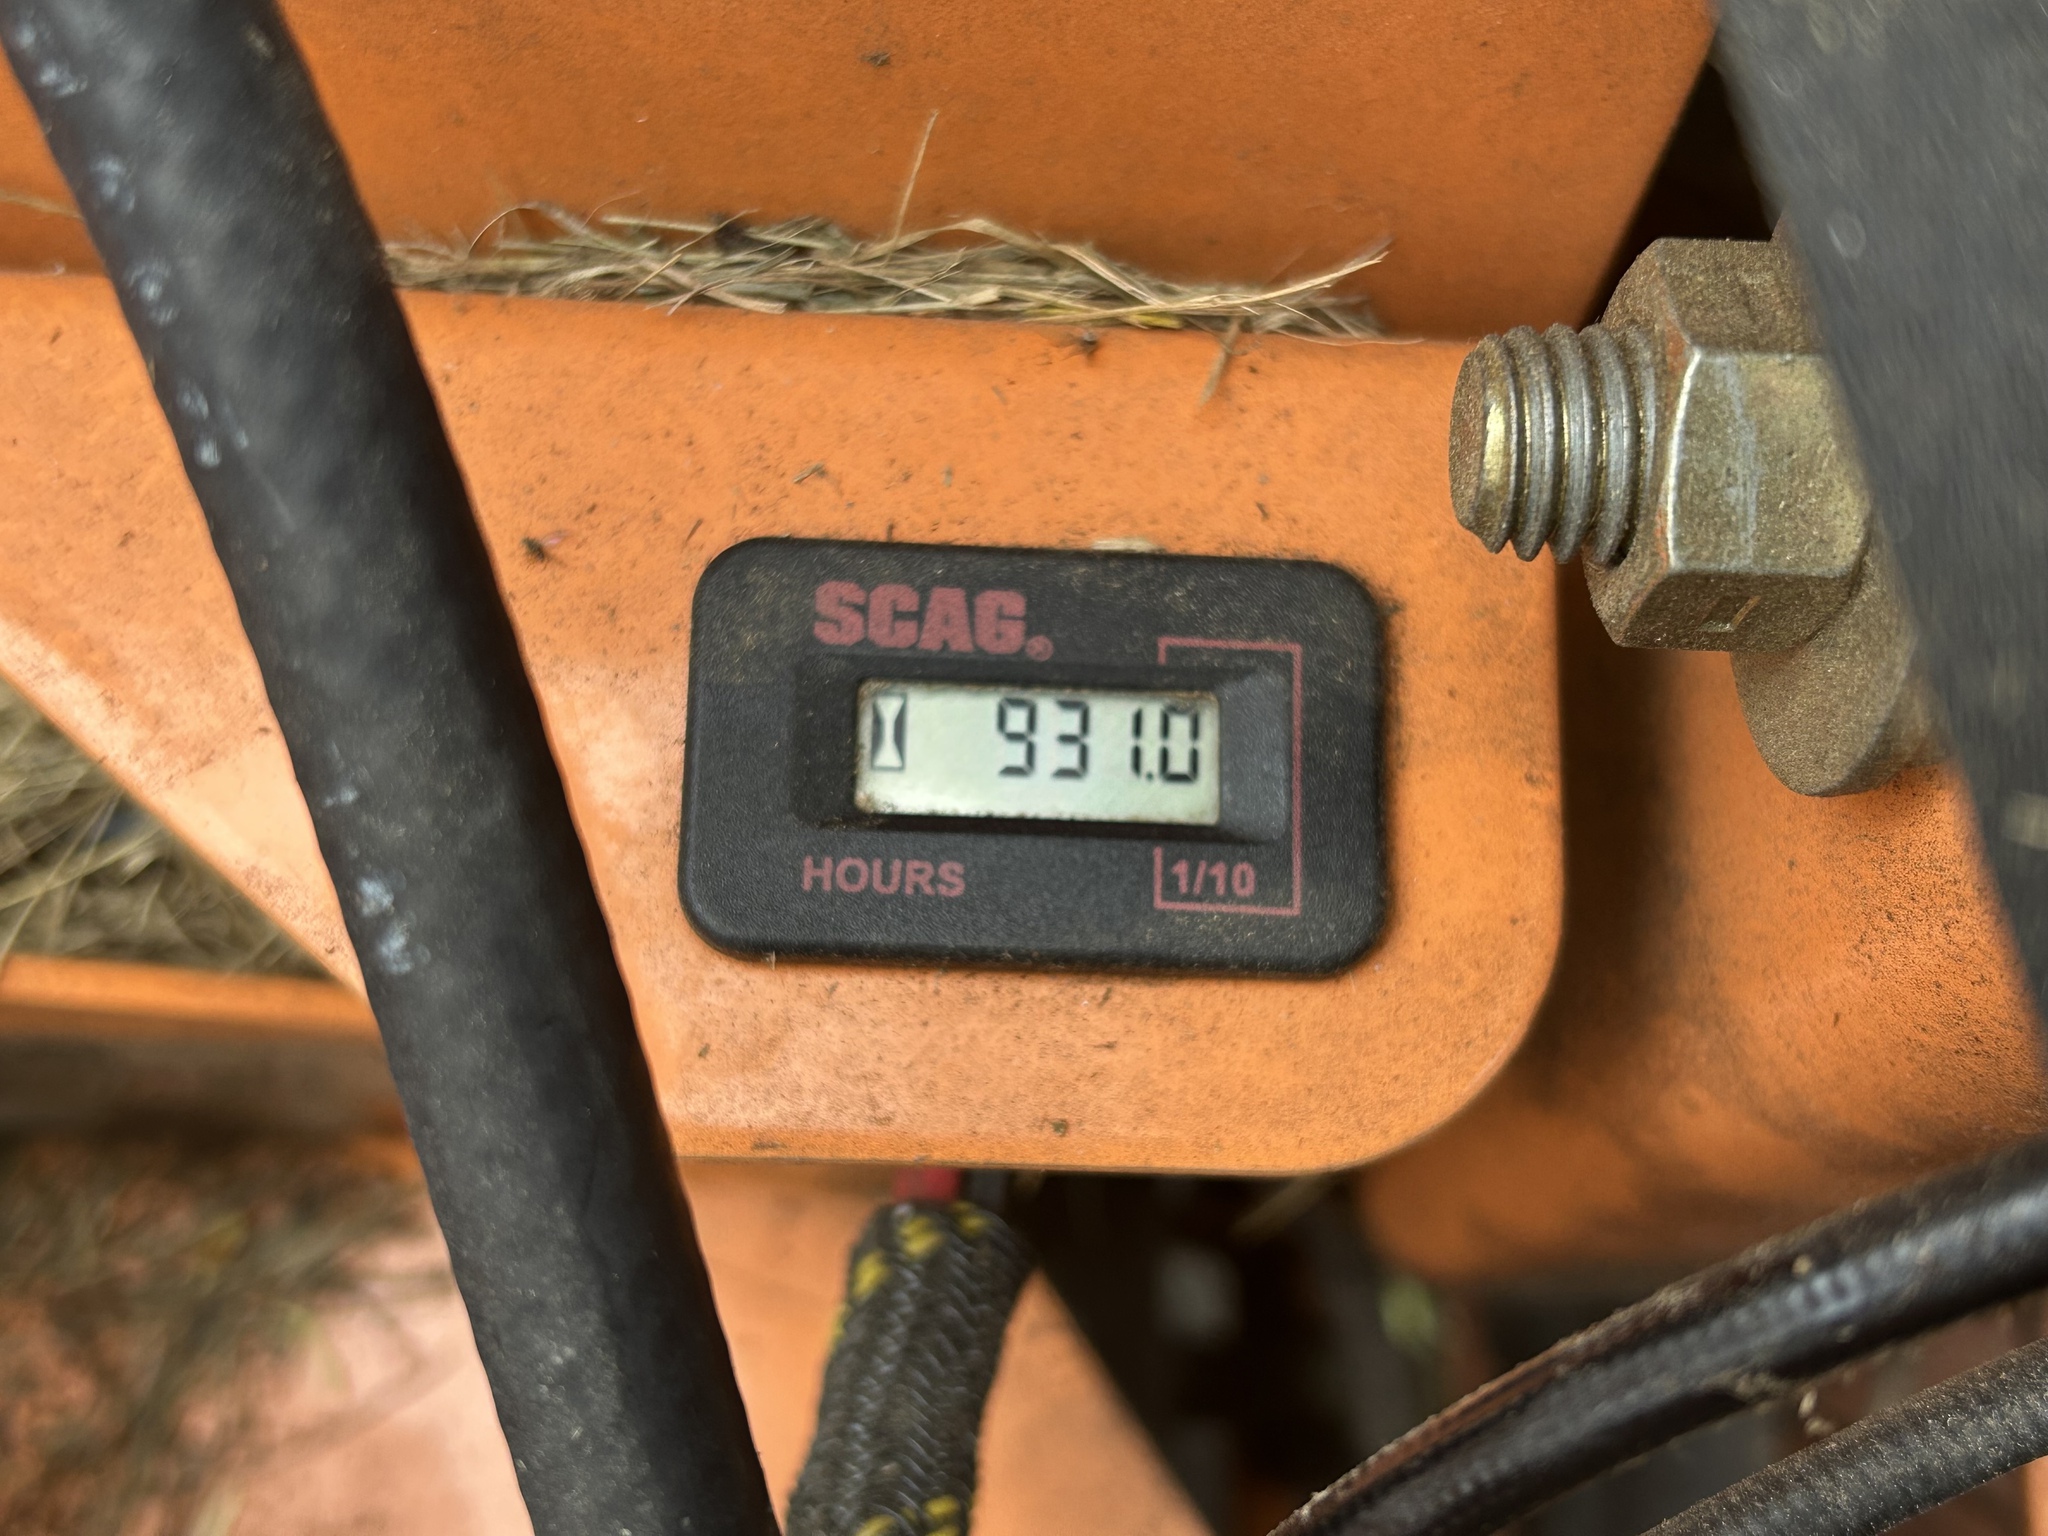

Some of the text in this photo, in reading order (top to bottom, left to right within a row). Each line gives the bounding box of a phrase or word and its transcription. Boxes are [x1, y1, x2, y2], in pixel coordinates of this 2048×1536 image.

[813, 580, 1027, 655] SCAG
[997, 697, 1199, 783] 931.0
[802, 855, 966, 897] HOURS
[1171, 859, 1256, 897] 1/10
